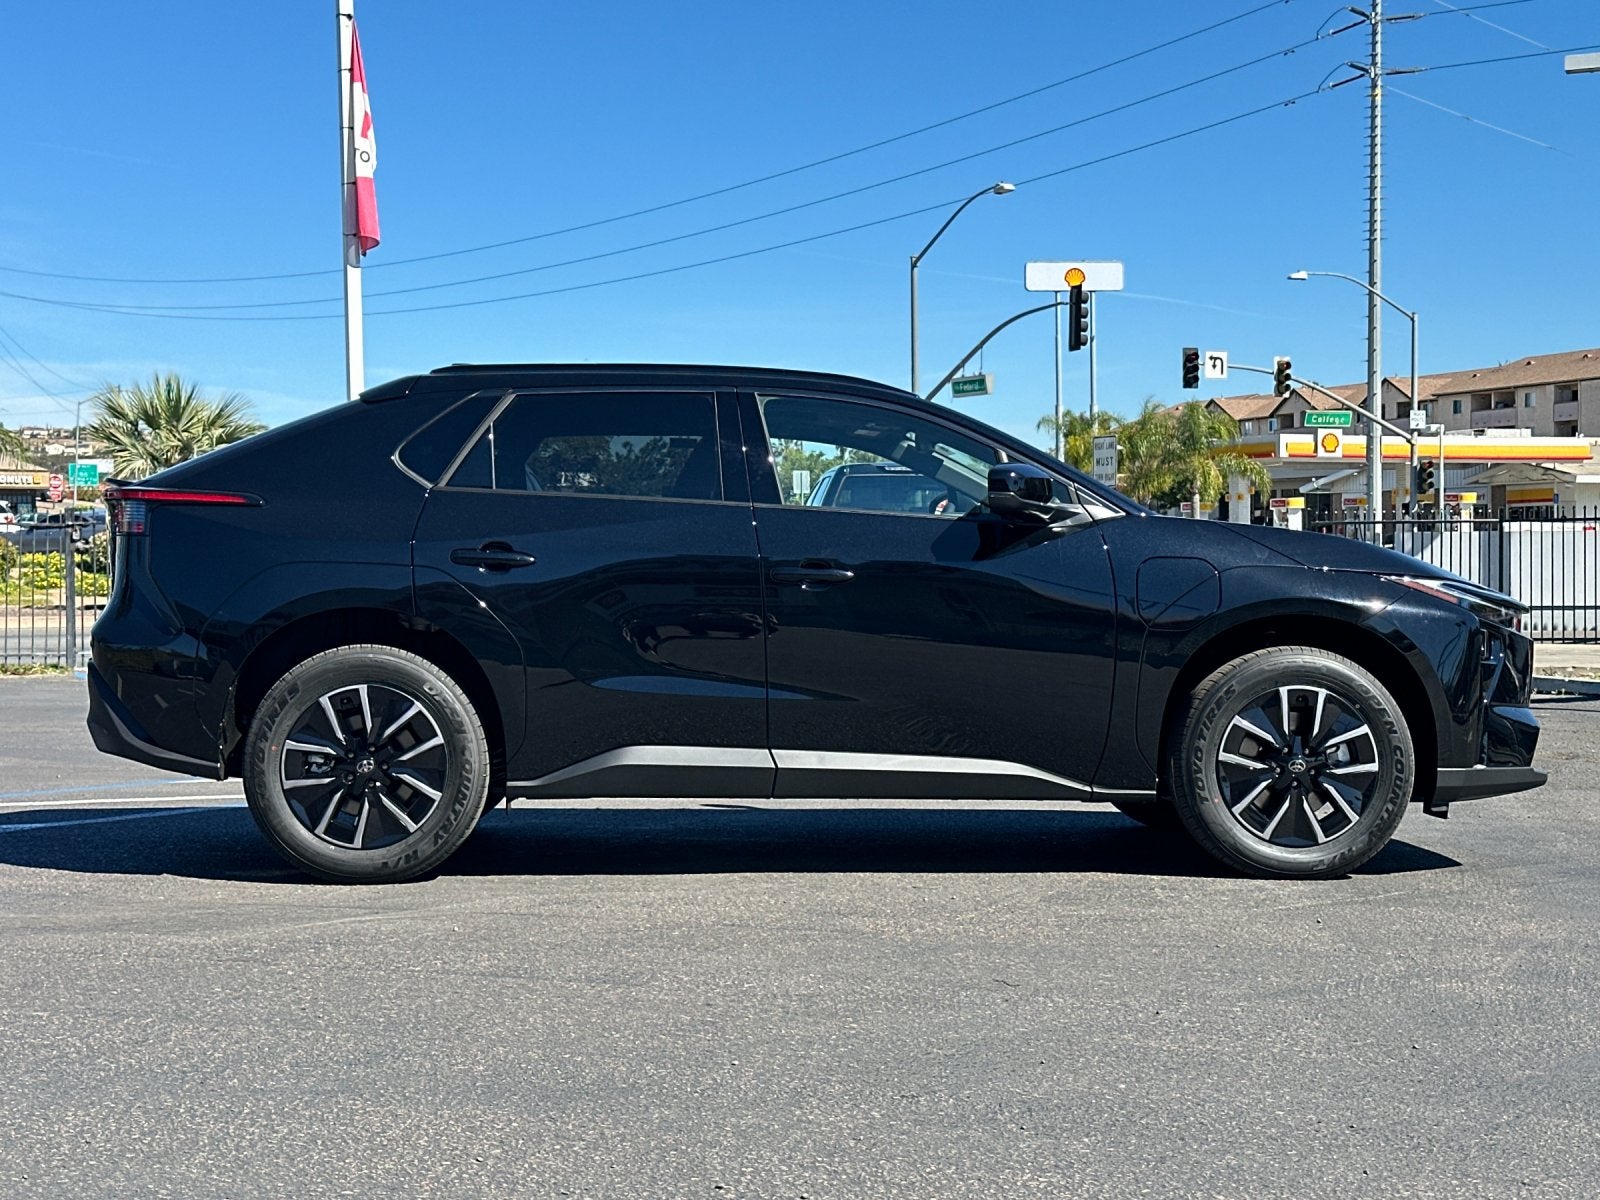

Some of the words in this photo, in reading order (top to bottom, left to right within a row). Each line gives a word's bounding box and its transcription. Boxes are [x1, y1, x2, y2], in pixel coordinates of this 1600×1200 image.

[959, 381, 979, 391] Federal
[1096, 456, 1114, 467] MUST
[1354, 682, 1398, 735] OPEN
[1191, 745, 1209, 804] TOYO
[1200, 682, 1237, 742] TIRES
[1366, 745, 1405, 846] COUNTRY
